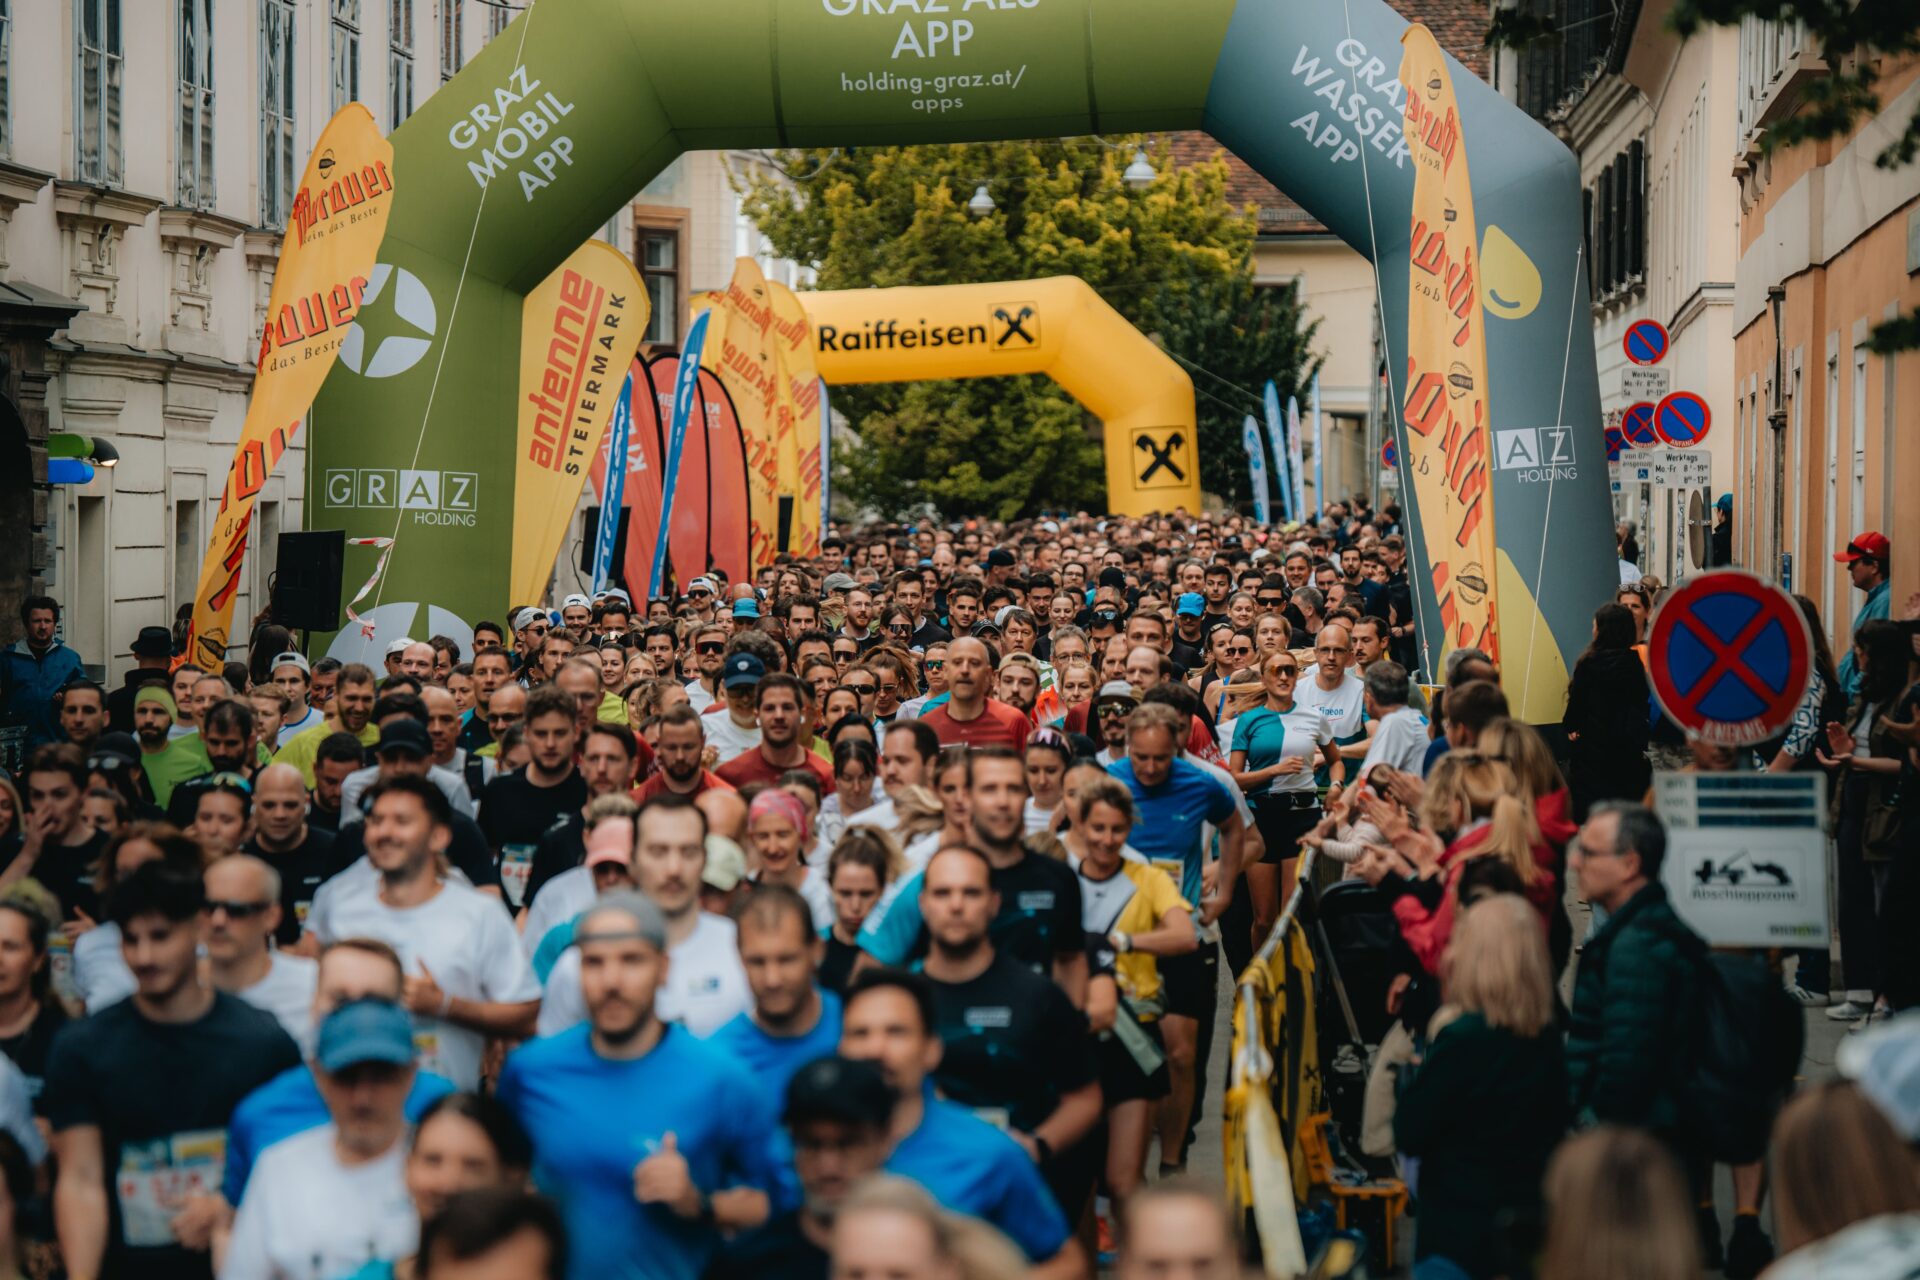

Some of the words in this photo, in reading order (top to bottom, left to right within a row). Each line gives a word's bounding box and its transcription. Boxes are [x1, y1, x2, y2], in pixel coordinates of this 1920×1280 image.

[891, 20, 974, 58] APP
[841, 65, 1027, 95] holding-graz.at/
[448, 64, 540, 149] GRAZ
[911, 97, 964, 114] apps
[1290, 44, 1412, 169] WASSER
[467, 91, 575, 188] MOBIL
[1289, 110, 1360, 163] APP
[518, 136, 574, 202] APP
[818, 319, 987, 352] Raiffeisen
[270, 357, 297, 373] das
[528, 268, 594, 469] antenne
[565, 293, 627, 477] STEIERMARK
[1517, 467, 1578, 483] HOLDING
[1665, 453, 1698, 463] Werktags
[328, 473, 471, 508] GRAZ
[414, 511, 477, 527] HOLDING
